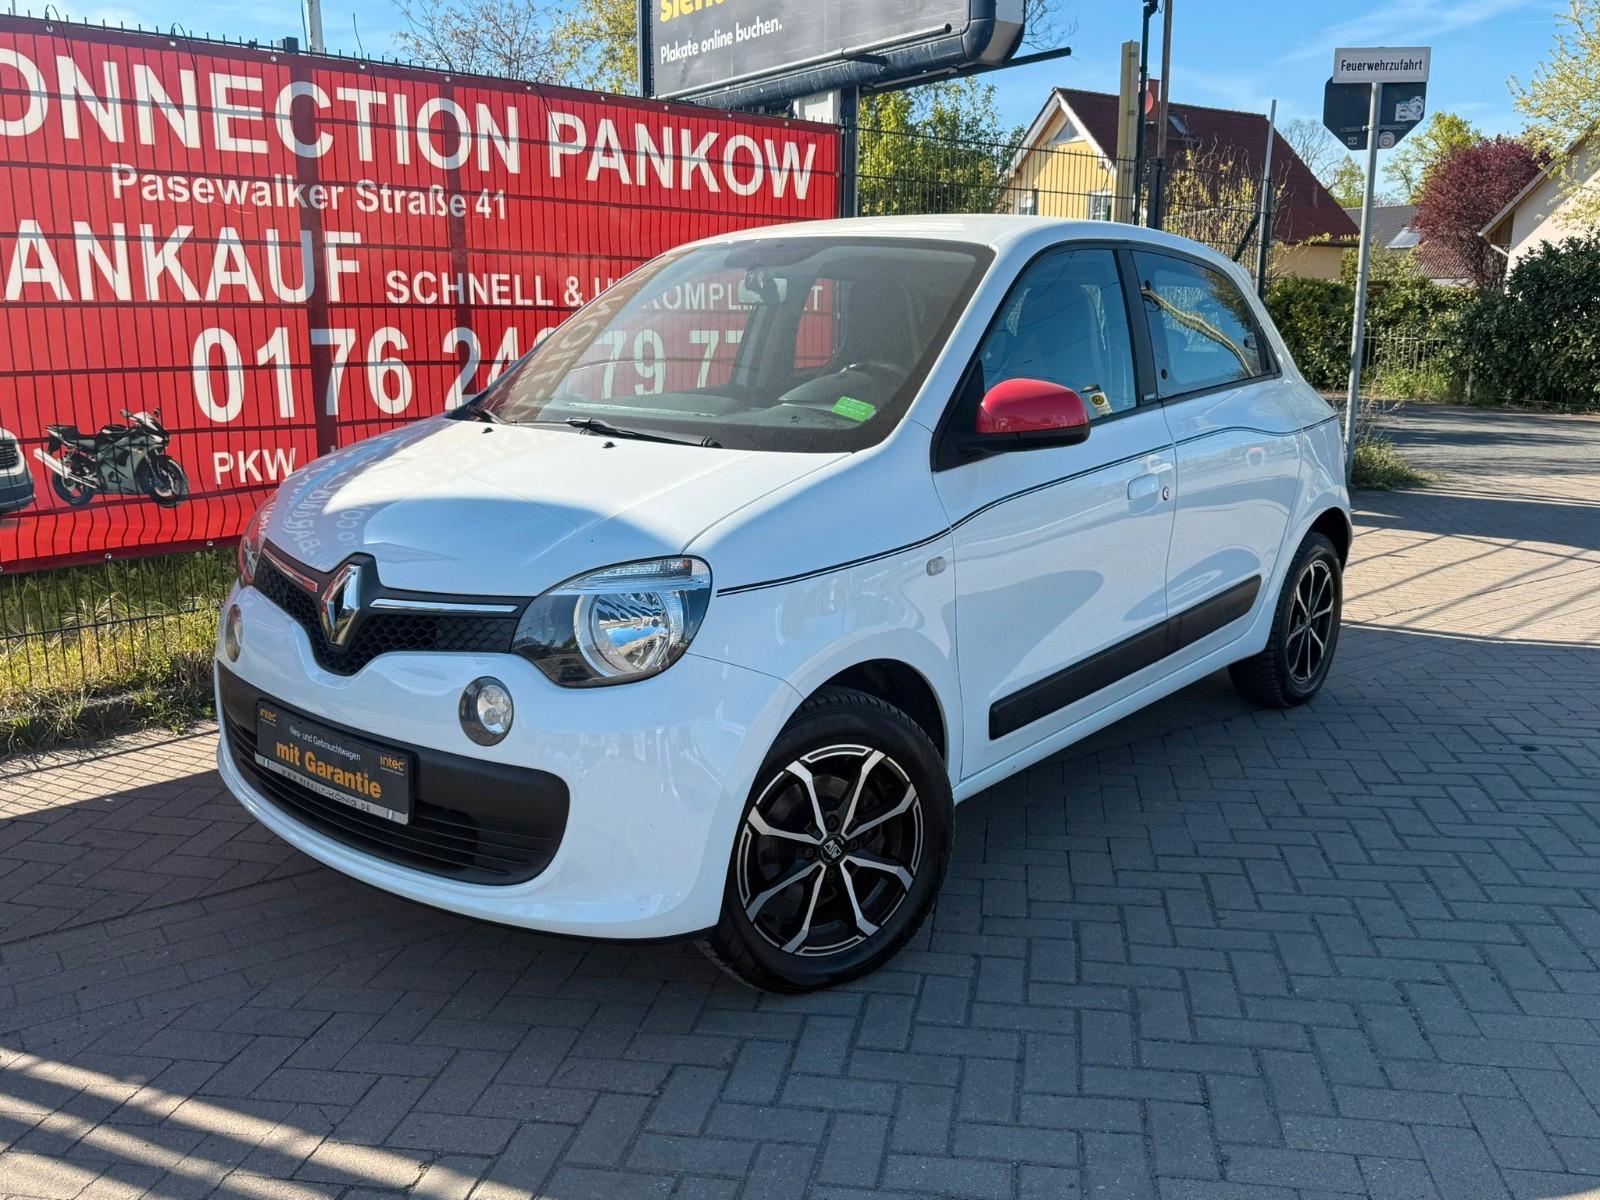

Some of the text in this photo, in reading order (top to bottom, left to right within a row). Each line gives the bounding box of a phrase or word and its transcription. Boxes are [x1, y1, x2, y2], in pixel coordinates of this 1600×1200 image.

[660, 16, 783, 64] Plakate online buchen.
[1340, 59, 1423, 71] Feuerwehrzufahrt
[548, 111, 817, 200] PANKOW
[111, 163, 506, 219] Pasewalker Straße 41
[386, 270, 553, 306] SCHNELL
[564, 275, 584, 307] &
[192, 326, 413, 423] 0176
[442, 326, 558, 412] 24
[591, 329, 665, 399] 79
[213, 447, 297, 485] PKW
[259, 708, 277, 723] intec
[276, 742, 382, 798] mit Garantie
[380, 755, 405, 771] intec
